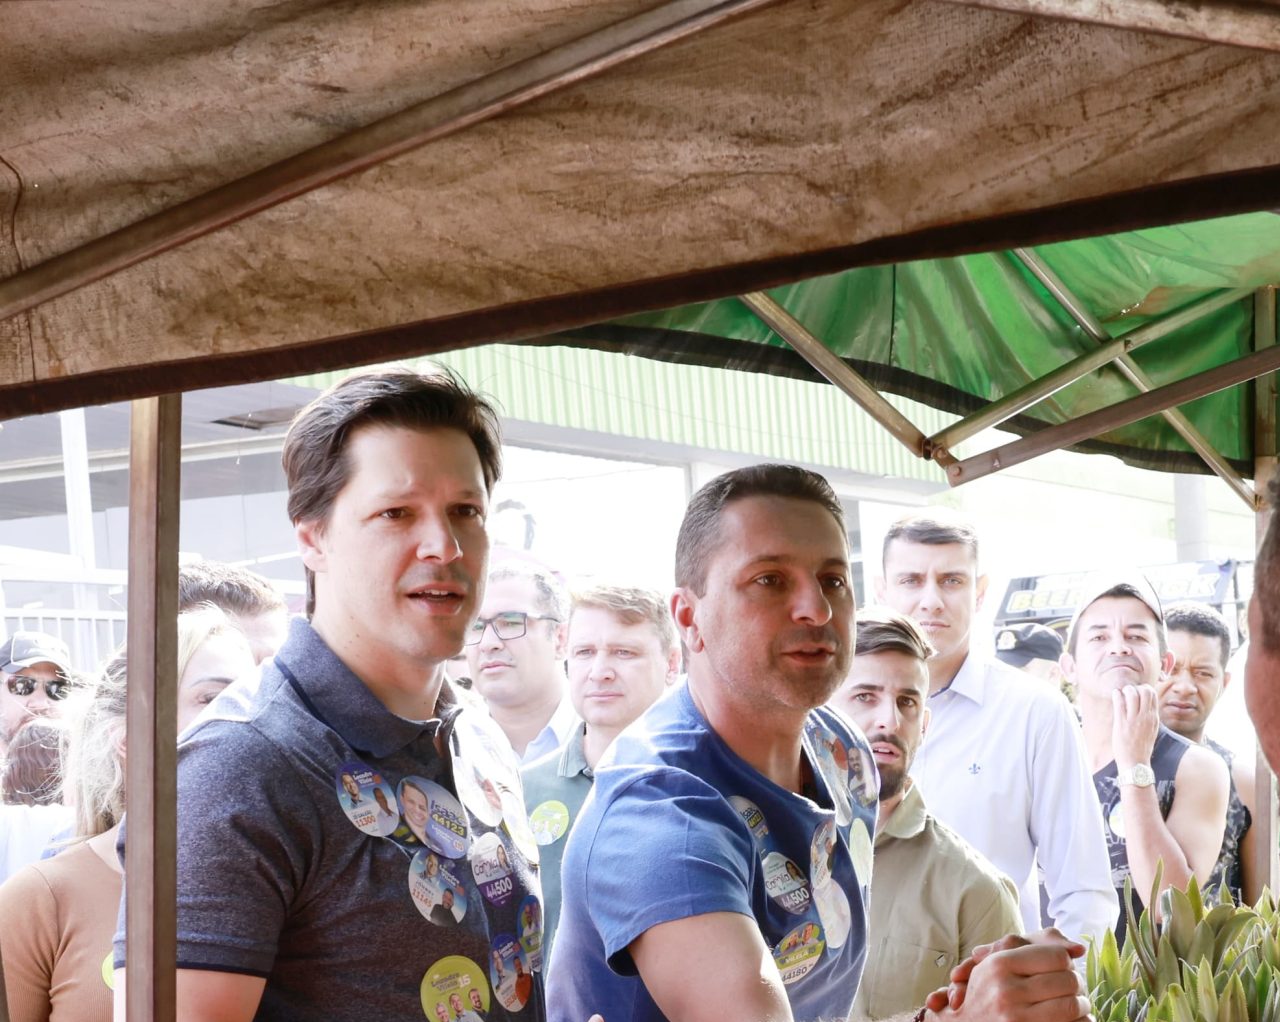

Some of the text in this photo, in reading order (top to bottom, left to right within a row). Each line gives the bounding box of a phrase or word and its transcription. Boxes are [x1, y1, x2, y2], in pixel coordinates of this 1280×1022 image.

[431, 800, 465, 825] Isaac
[432, 813, 465, 836] 44123
[486, 877, 513, 898] 44500
[781, 887, 810, 909] 44500
[459, 974, 471, 988] 15
